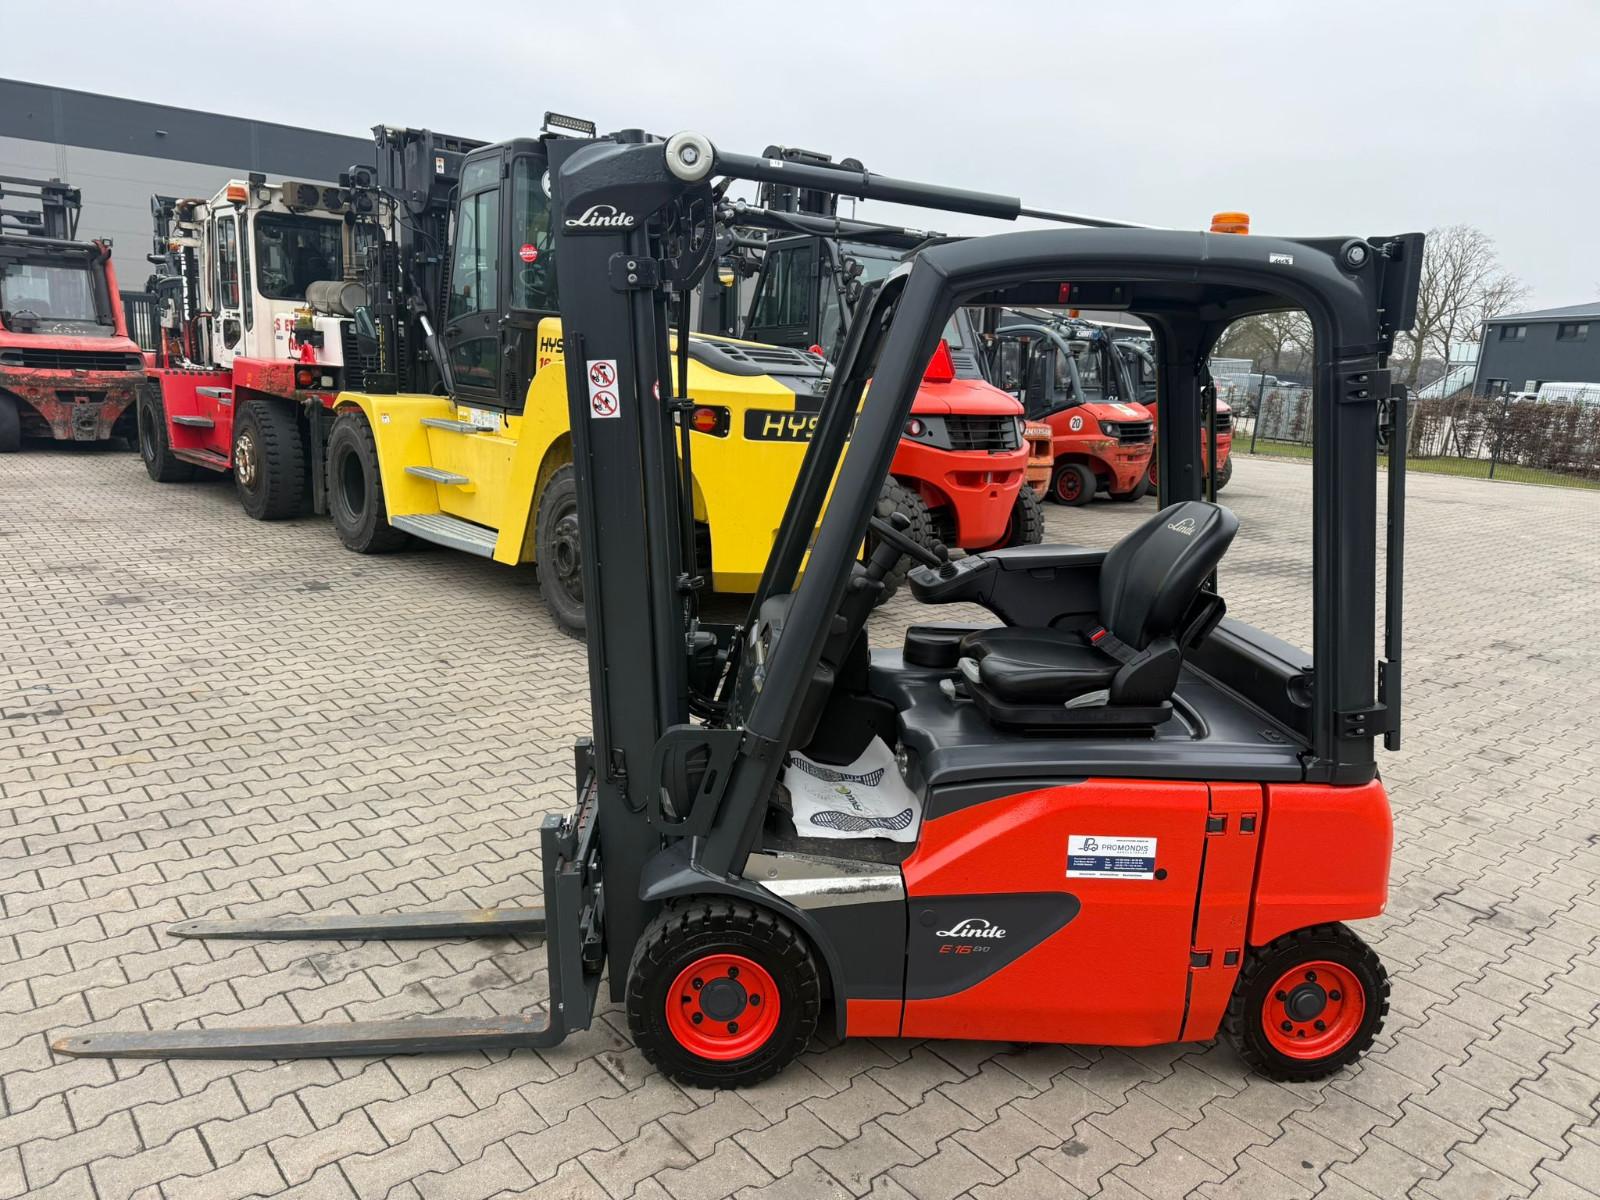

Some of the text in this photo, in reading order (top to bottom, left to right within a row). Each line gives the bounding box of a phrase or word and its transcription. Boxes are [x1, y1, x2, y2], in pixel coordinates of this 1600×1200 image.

[565, 204, 634, 226] Linde
[1072, 418, 1081, 428] 20
[1101, 844, 1149, 852] PROMONDIS
[935, 918, 1007, 939] Linde
